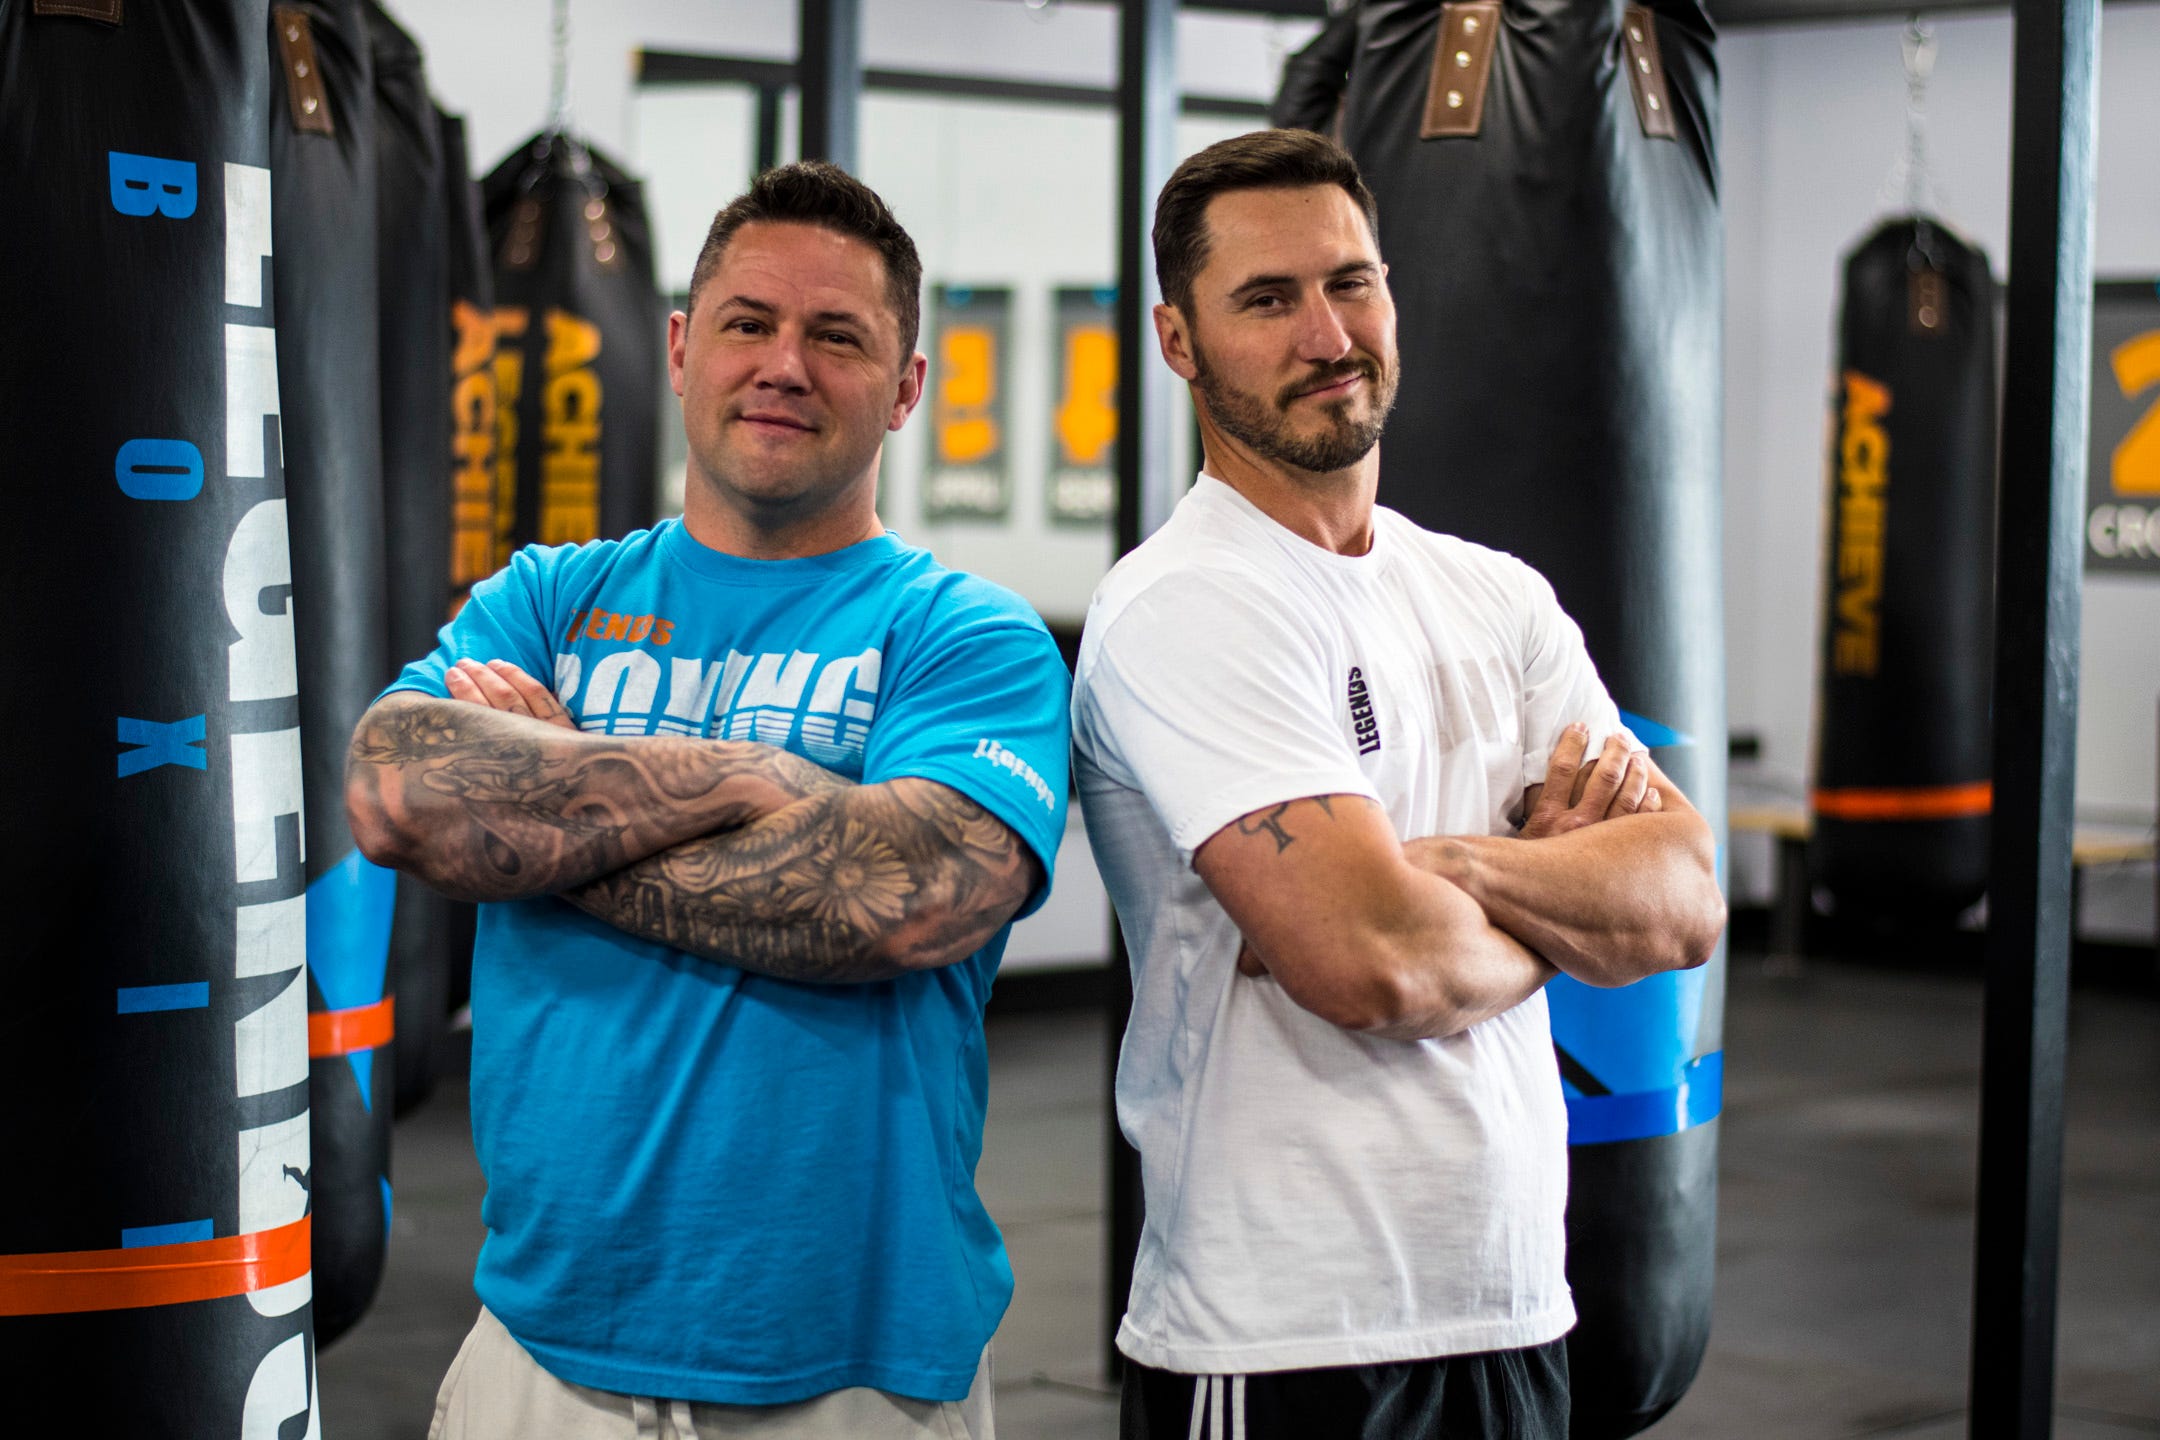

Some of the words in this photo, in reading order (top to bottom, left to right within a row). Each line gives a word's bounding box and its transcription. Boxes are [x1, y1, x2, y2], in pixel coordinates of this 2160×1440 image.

[451, 299, 496, 622] ACHIE
[1836, 370, 1892, 677] ACHIEVE
[1348, 667, 1381, 756] LEGENDS
